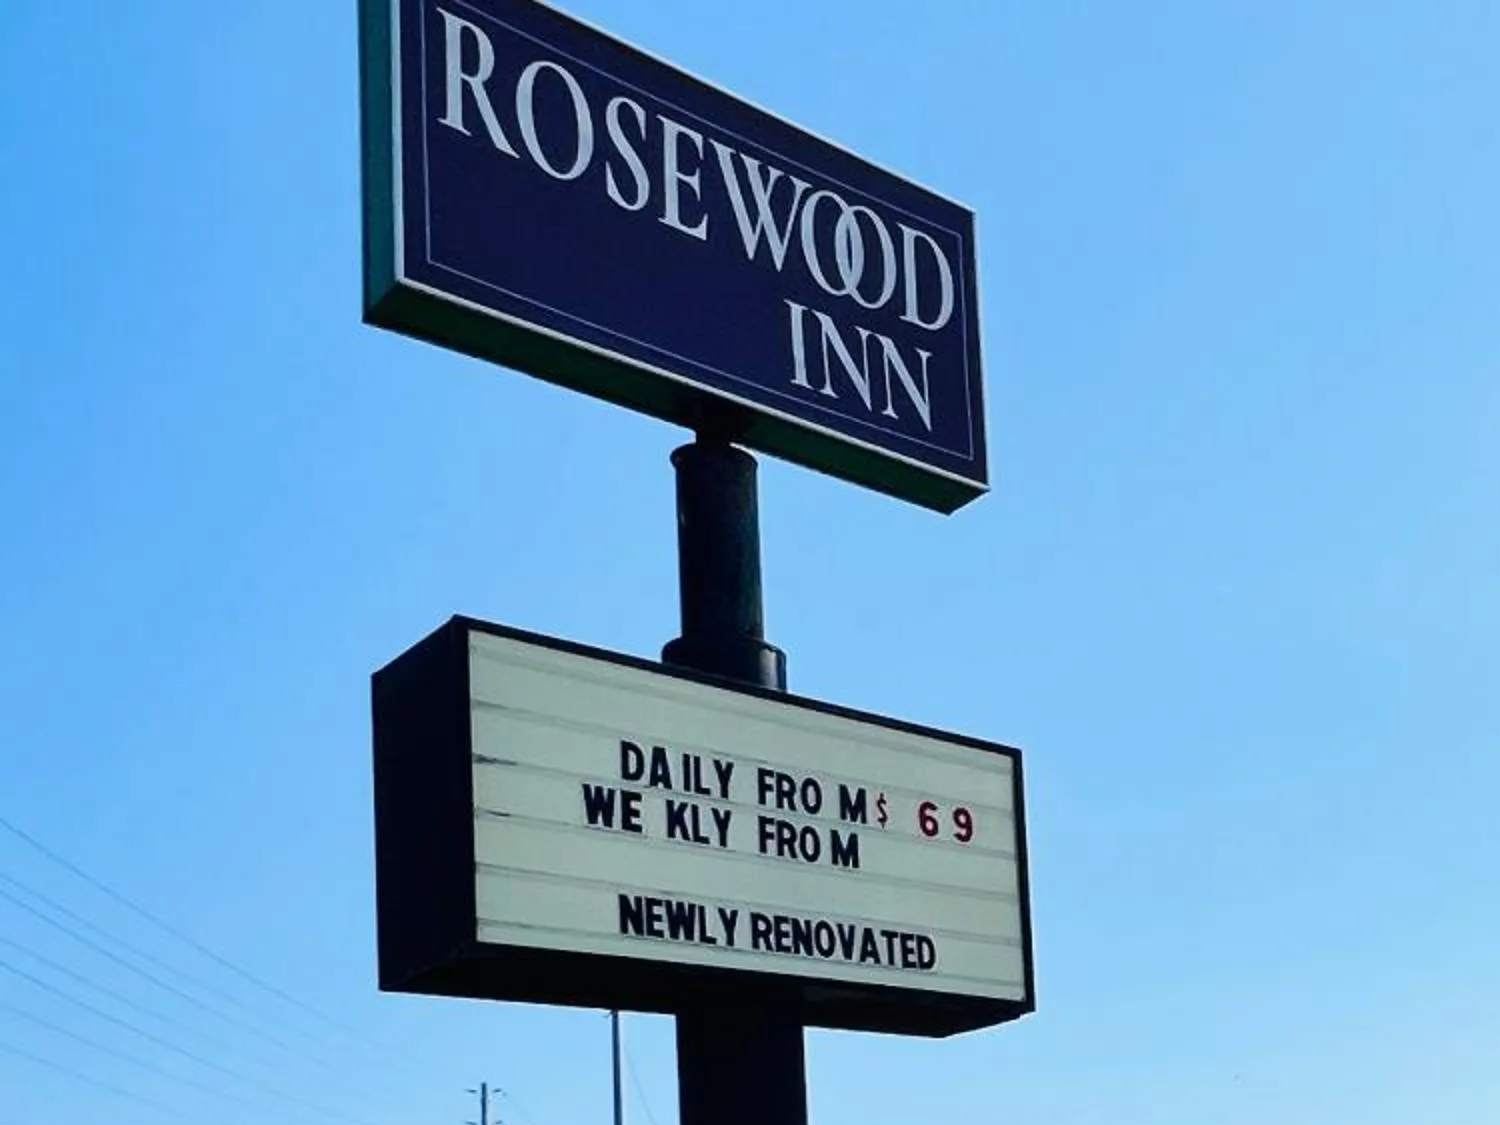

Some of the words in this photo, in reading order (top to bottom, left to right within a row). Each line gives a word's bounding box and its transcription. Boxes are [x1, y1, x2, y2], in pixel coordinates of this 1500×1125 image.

[436, 8, 954, 331] ROSEWOOD
[783, 299, 934, 431] INN
[619, 740, 735, 798] DAILY
[756, 768, 868, 824] FROM
[757, 815, 861, 868] FROM
[618, 894, 739, 948] NEWLY
[750, 912, 937, 970] RENOVATED
